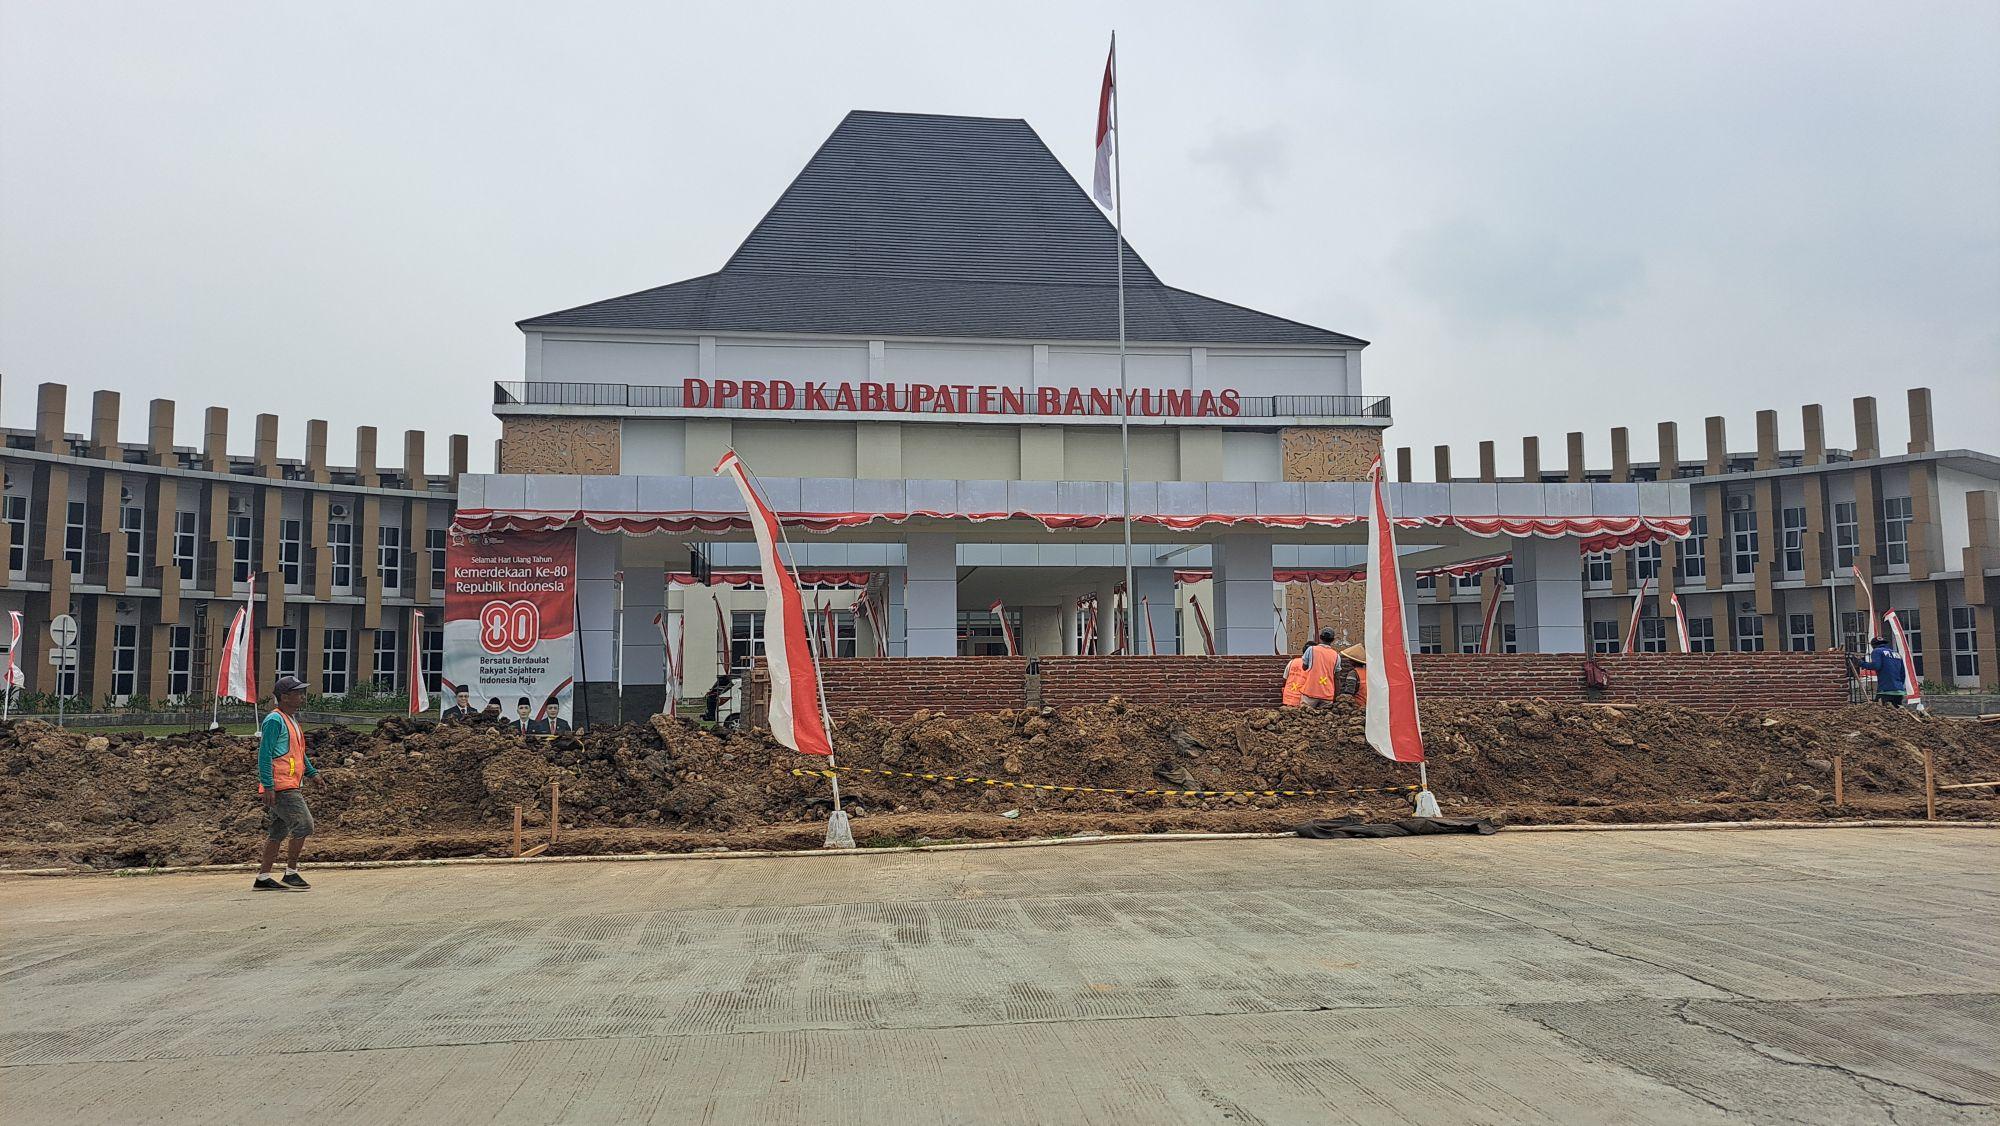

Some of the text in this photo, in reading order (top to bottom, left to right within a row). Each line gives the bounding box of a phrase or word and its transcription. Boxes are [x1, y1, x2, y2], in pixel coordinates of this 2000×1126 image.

[683, 378, 1241, 417] DPRD KABUPATEN BANYUMAS
[471, 555, 553, 565] Selamat Hari Ulang Tahun
[454, 565, 568, 578] Kemerdekaan Ke-80
[456, 580, 565, 594] Republik Indonesia
[479, 600, 539, 654] 80
[480, 656, 550, 664] Bersatu Berdaulat
[479, 666, 546, 676] Rakyat Sejahtera
[479, 676, 536, 685] Indonesia Maju
